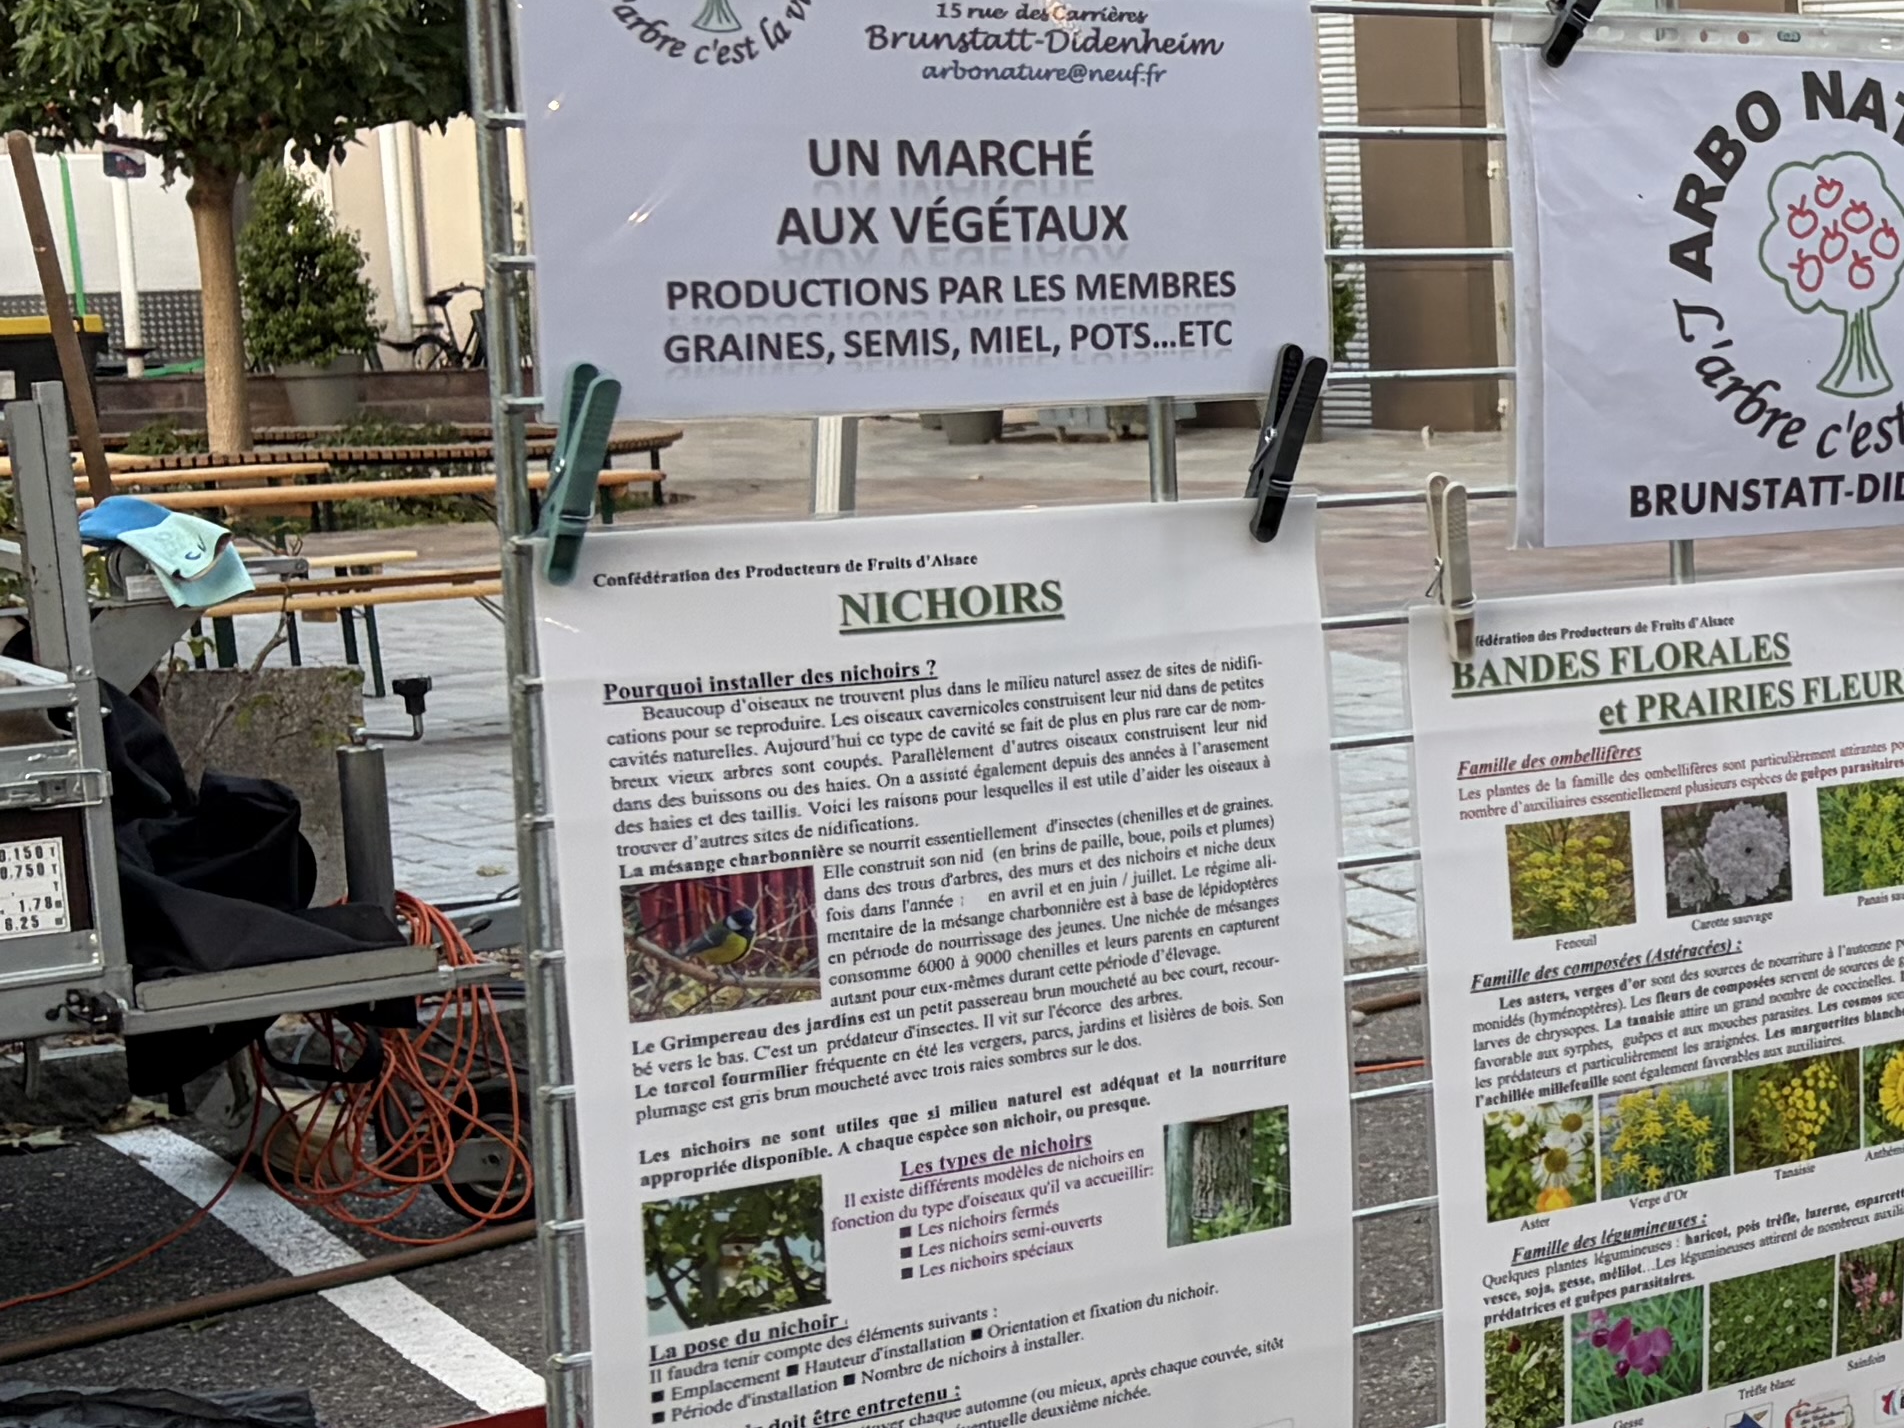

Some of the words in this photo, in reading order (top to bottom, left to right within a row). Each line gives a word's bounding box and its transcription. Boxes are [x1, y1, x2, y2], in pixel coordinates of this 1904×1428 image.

[808, 138, 880, 177] UN
[897, 130, 1094, 177] MARCHÉ
[1668, 88, 1782, 283] ARBO
[776, 206, 879, 246] AUX
[890, 196, 1129, 244] VÉGÉTAUX
[666, 276, 929, 311] PRODUCTIONS
[938, 275, 1004, 305] PAR
[1013, 274, 1066, 303] LES
[1076, 270, 1237, 301] MEMBRES
[663, 331, 836, 366] GRAINES,
[844, 327, 960, 361] SEMIS,
[970, 325, 1061, 358] MIEL,
[1070, 319, 1233, 351] POTS...ETC
[838, 579, 1063, 627] NICHOIRS
[603, 676, 707, 706] Pourquoi
[705, 671, 799, 698] installer
[797, 668, 838, 691] des
[837, 661, 924, 688] nichoirs
[1450, 649, 1601, 691] BANDES
[1610, 631, 1790, 676] FLORALES
[1599, 699, 1627, 727] et
[1636, 679, 1795, 723] PRAIRIES
[899, 1160, 934, 1183] Les
[938, 1153, 985, 1179] types
[992, 1145, 1014, 1163] de
[1019, 1133, 1094, 1163] nichoirs
